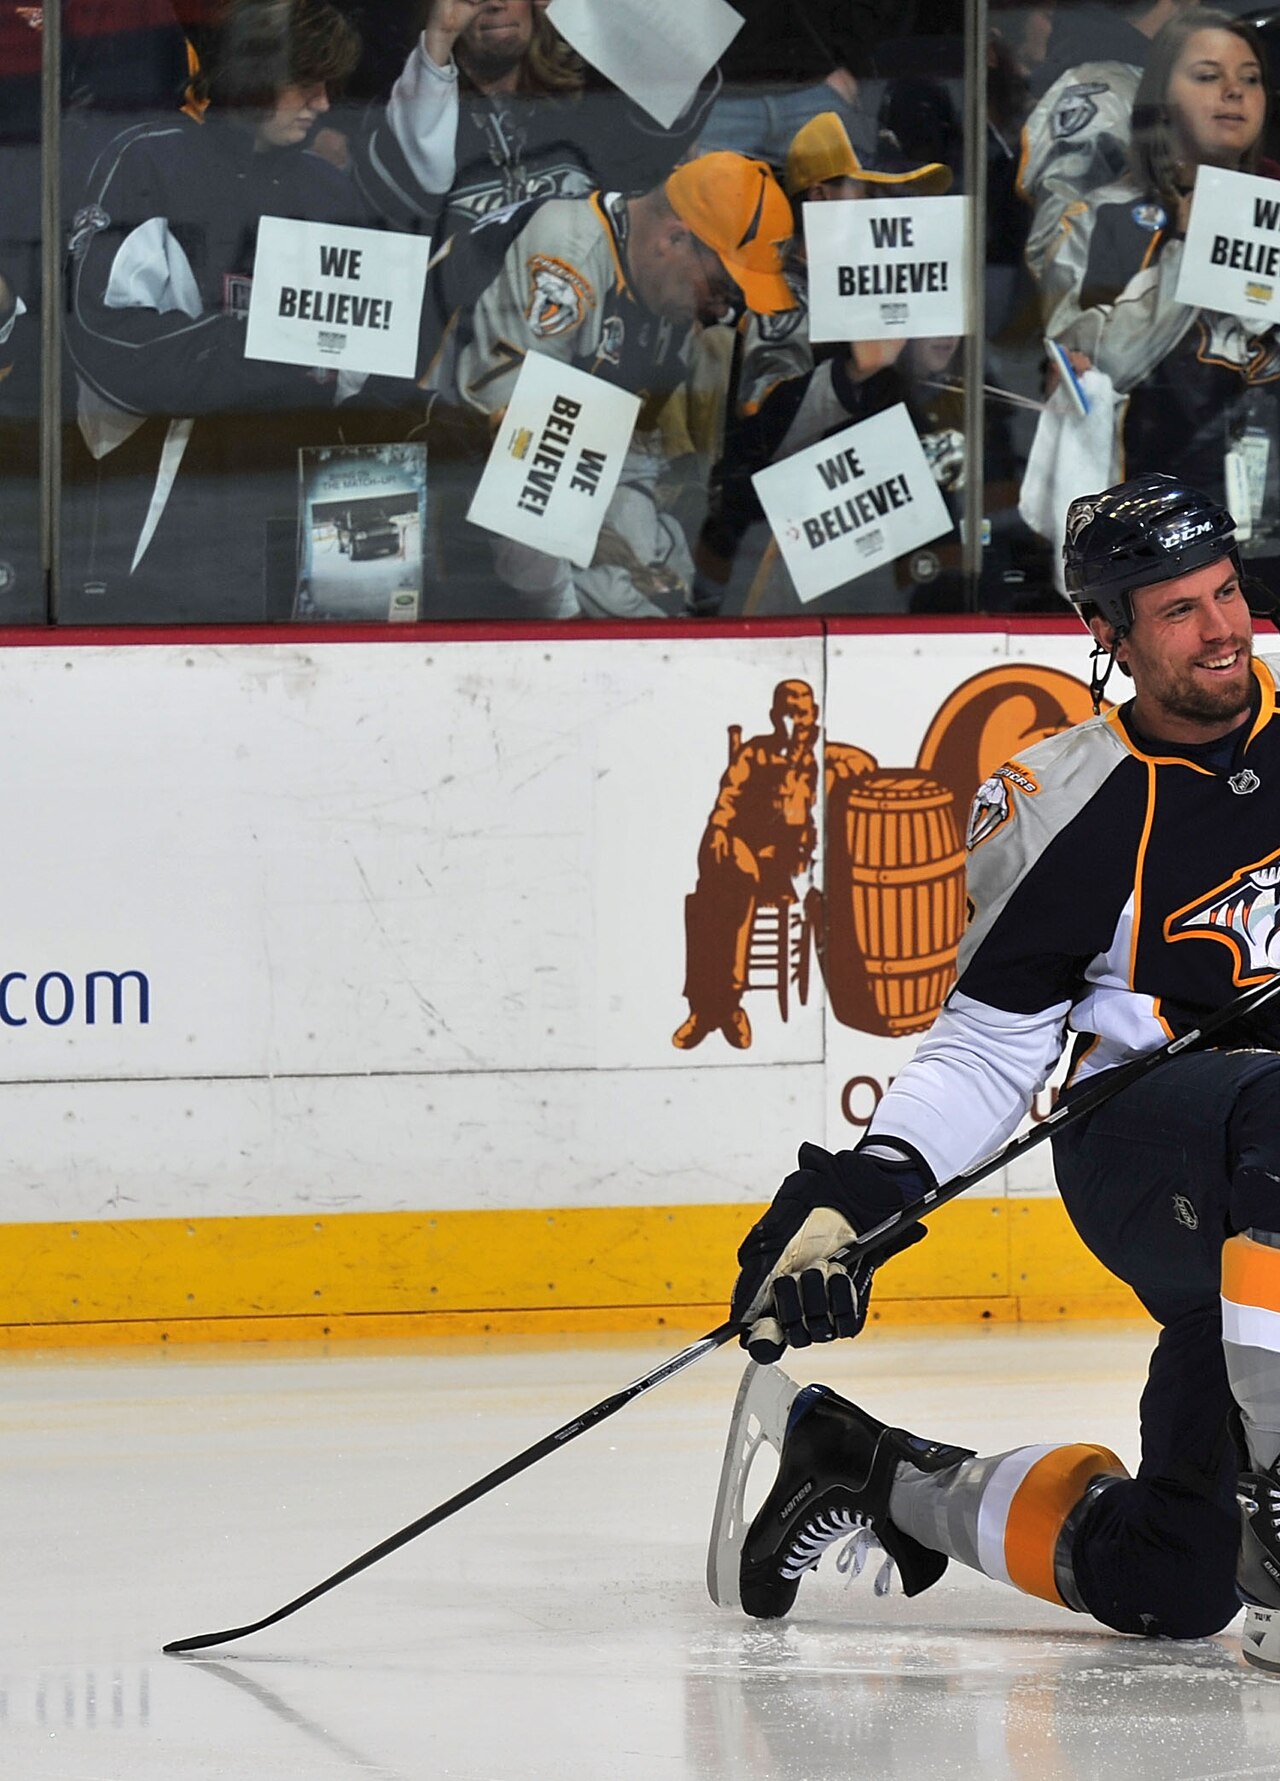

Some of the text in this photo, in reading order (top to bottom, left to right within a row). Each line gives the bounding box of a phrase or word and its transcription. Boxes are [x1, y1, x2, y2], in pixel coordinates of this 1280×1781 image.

[870, 217, 914, 249] WE
[320, 245, 362, 280] WE
[838, 261, 948, 297] BELIEVE!
[278, 286, 393, 330] BELIEVE!
[517, 395, 582, 517] BELIEVE!
[570, 449, 607, 497] WE
[816, 447, 865, 491] WE
[802, 473, 914, 550] BELIEVE!
[1163, 521, 1214, 549] CCM
